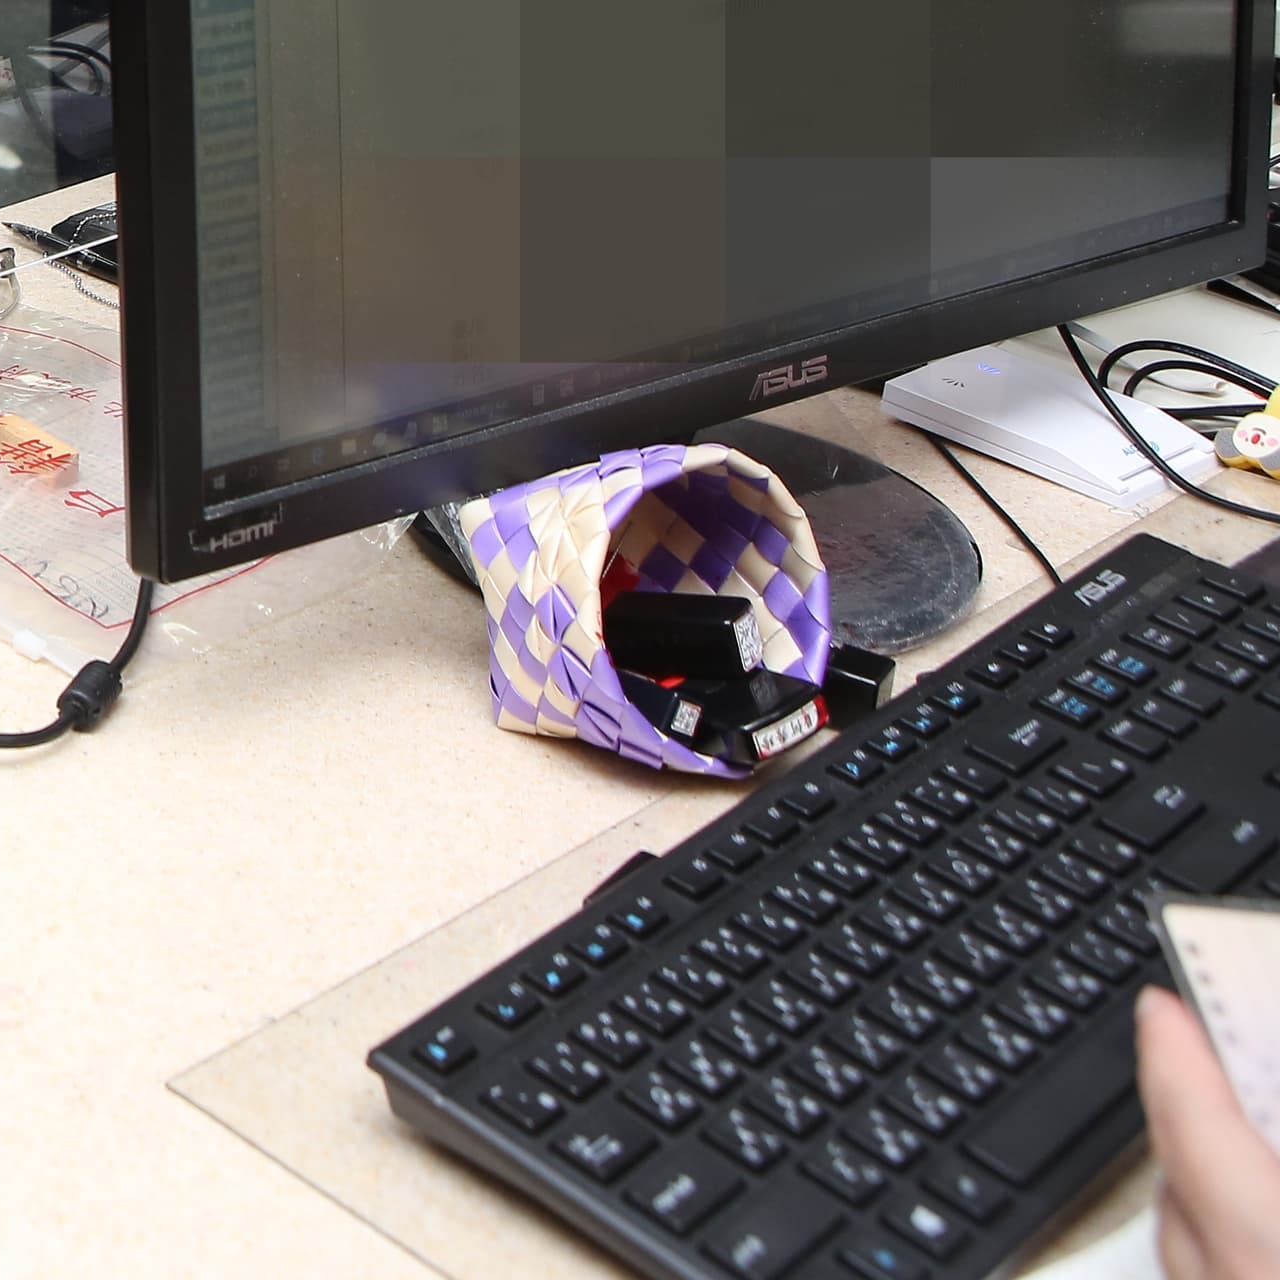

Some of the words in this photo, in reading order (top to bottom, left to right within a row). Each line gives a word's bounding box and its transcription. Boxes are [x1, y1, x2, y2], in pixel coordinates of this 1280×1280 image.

[748, 354, 829, 401] ASUS
[209, 519, 276, 554] HDMI
[1073, 569, 1127, 607] ASUS
